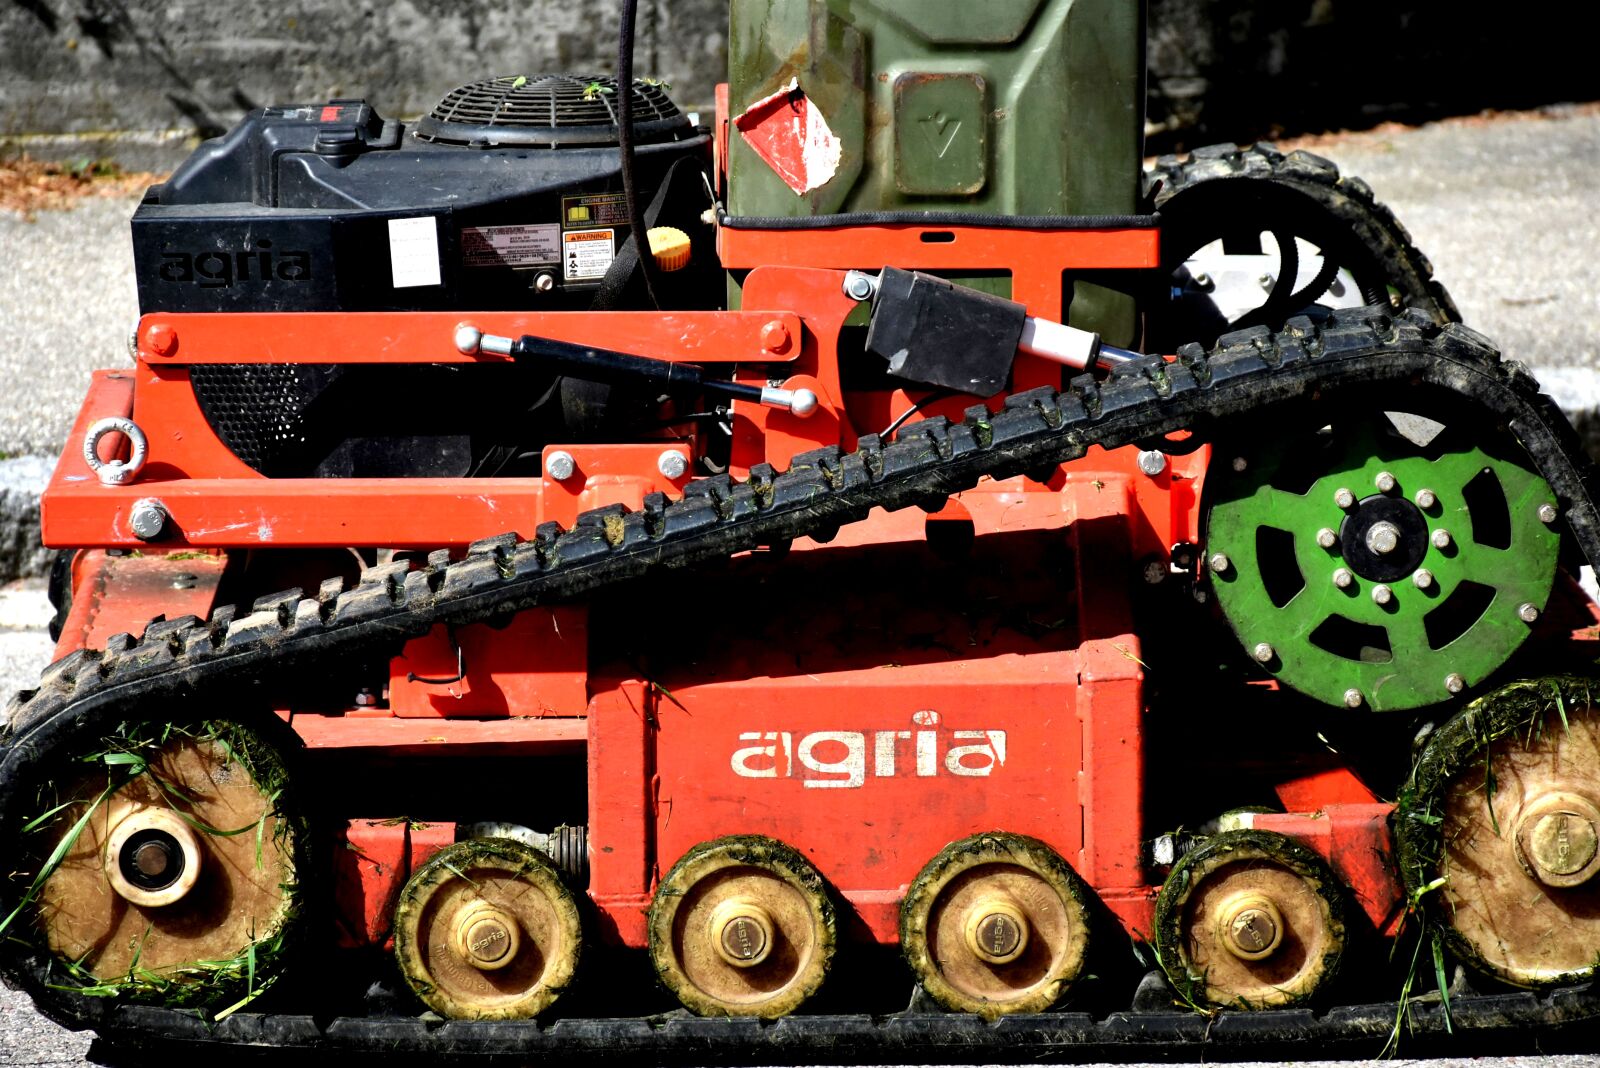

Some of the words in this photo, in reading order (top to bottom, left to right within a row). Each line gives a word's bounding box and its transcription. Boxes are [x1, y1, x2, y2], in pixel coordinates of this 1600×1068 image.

[576, 232, 607, 241] WARNING
[160, 239, 311, 289] agria
[730, 709, 1007, 789] agria
[470, 929, 506, 952] agria
[737, 920, 752, 957] agria
[994, 917, 1005, 954] agria
